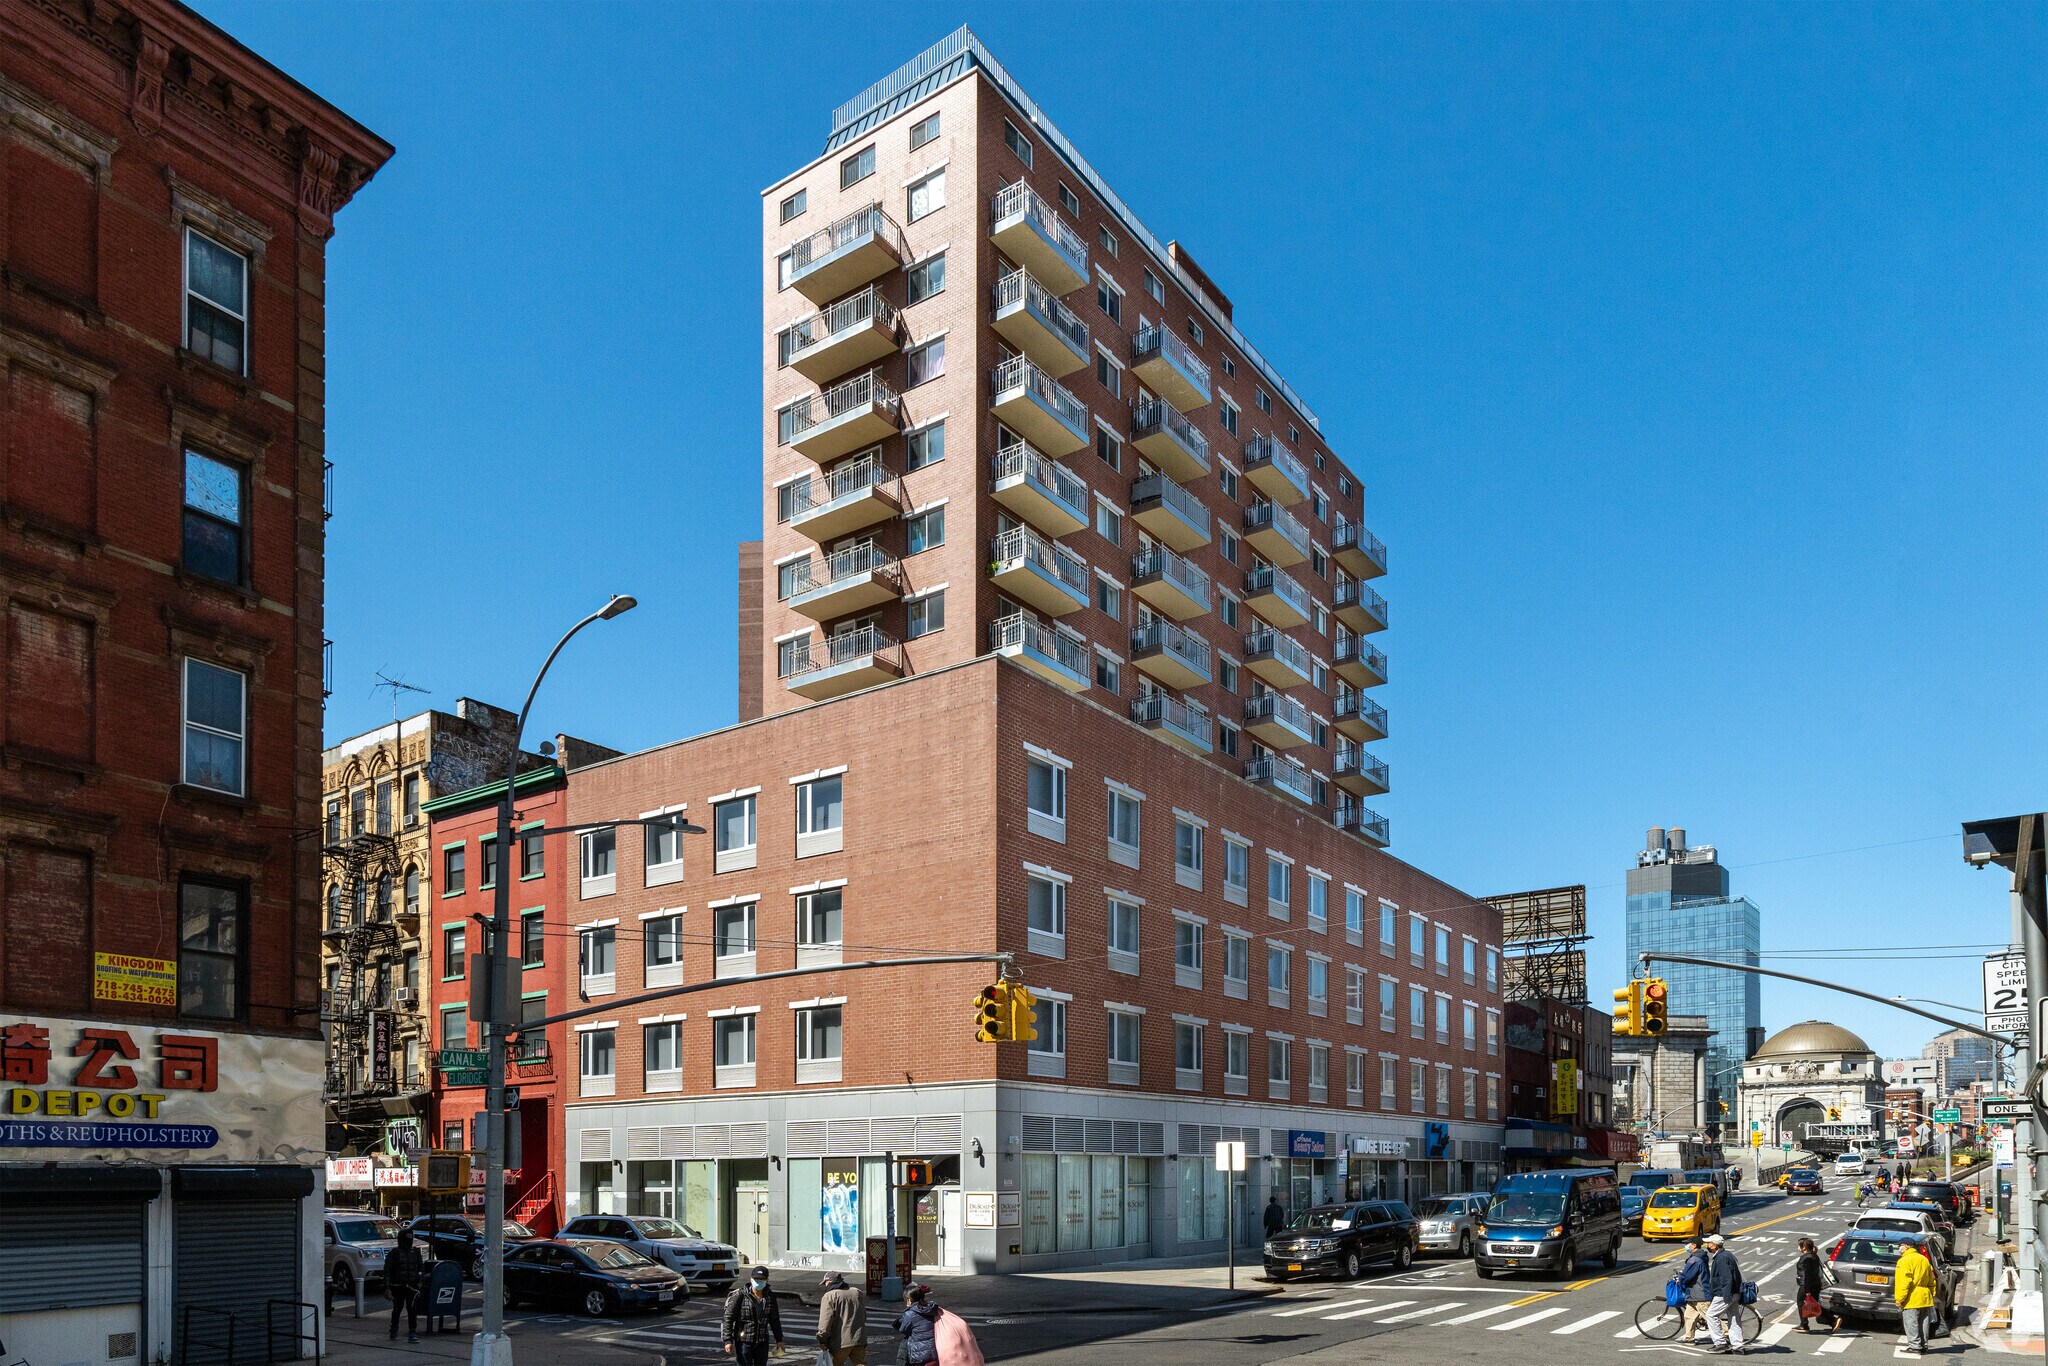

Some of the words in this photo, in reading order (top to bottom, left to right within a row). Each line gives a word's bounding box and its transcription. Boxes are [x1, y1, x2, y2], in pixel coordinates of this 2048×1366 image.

[108, 955, 165, 971] KINGDOM
[96, 965, 122, 974] ROOFING
[128, 968, 175, 980] WATERPROOFING
[1996, 970, 2027, 978] SPEE
[96, 980, 175, 997] 718-745-7475
[2001, 978, 2026, 986] LIMI
[96, 989, 175, 1005] 718-434-0020
[1991, 1022, 2029, 1031] ENFOR
[442, 1052, 475, 1066] CANAL
[448, 1071, 483, 1085] ELDRIDGE
[10, 1088, 166, 1118] DEPOT
[1994, 1105, 2018, 1113] ONE
[0, 1125, 46, 1141] THS
[50, 1126, 64, 1141] &
[66, 1126, 213, 1144] REUPHOLSTERY
[349, 1159, 368, 1175] CHINESE
[827, 1172, 840, 1184] BE
[869, 1270, 886, 1280] LOVE
